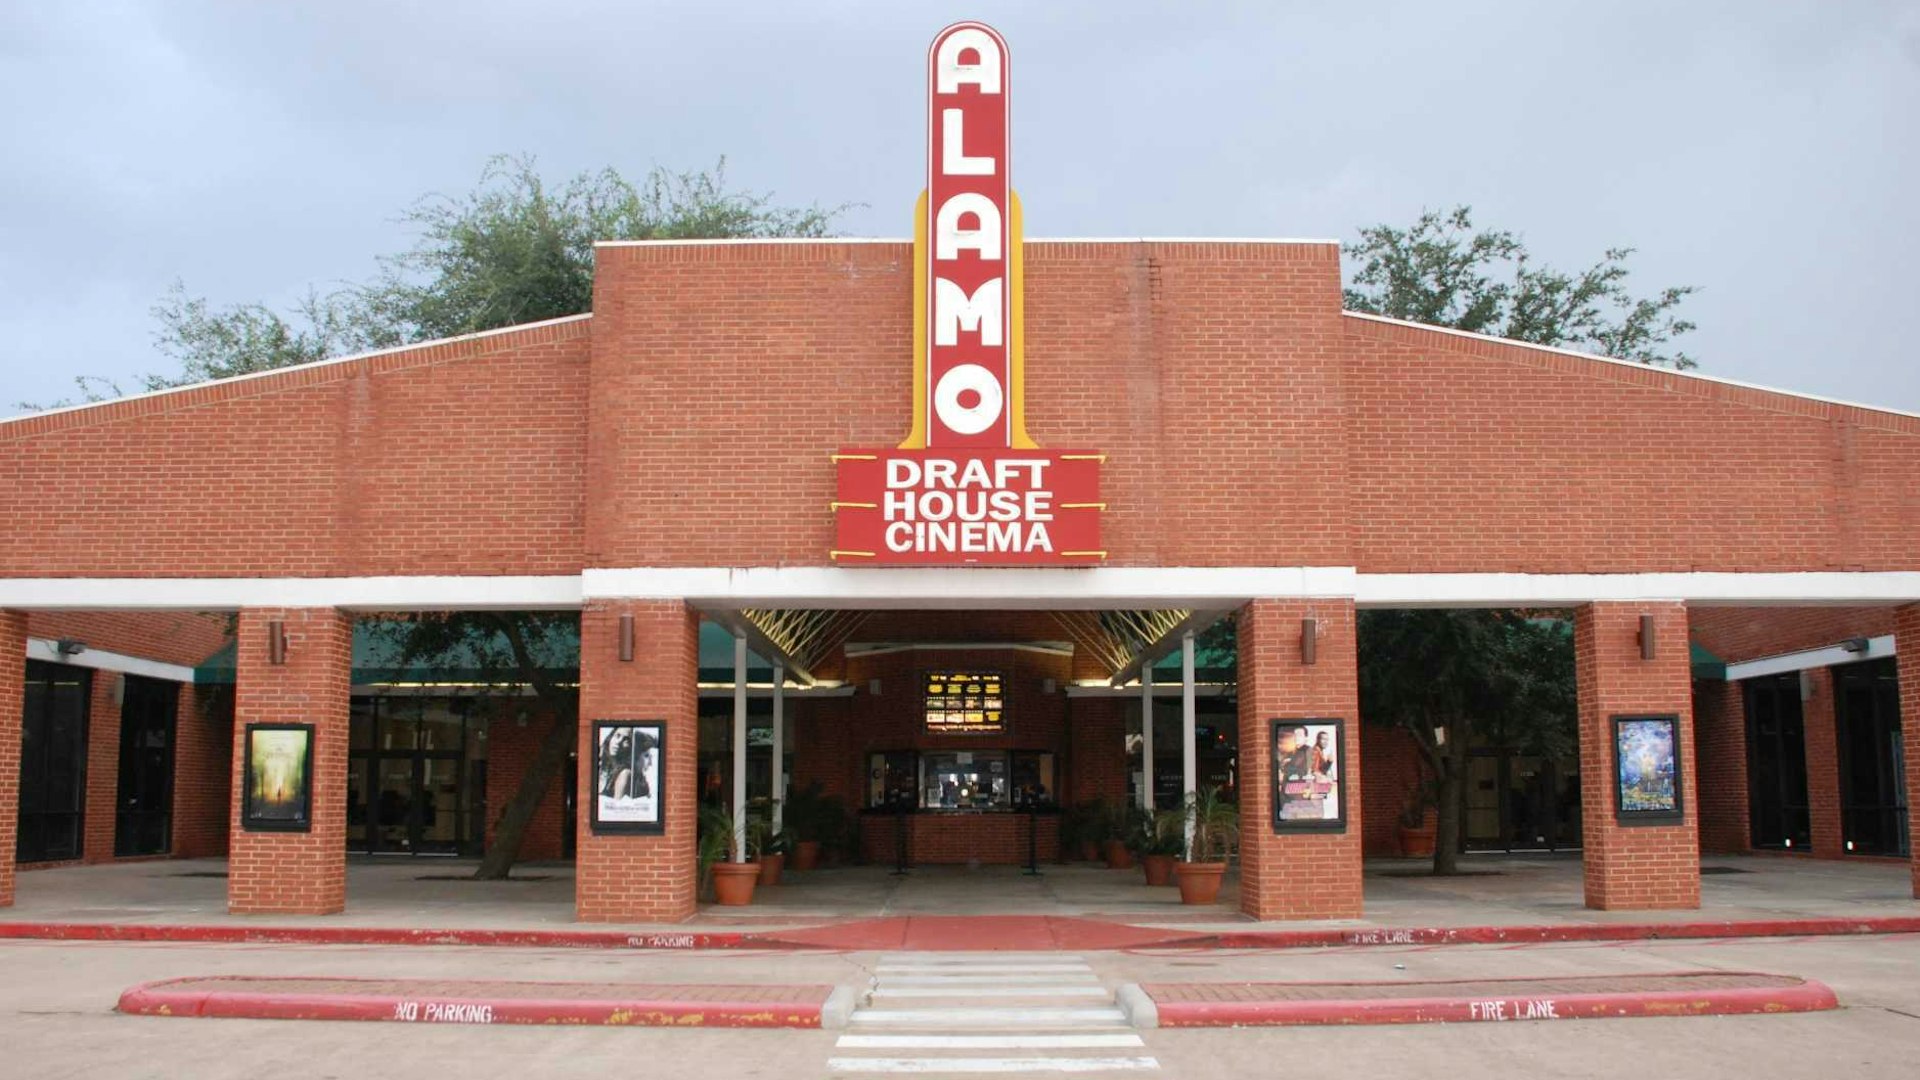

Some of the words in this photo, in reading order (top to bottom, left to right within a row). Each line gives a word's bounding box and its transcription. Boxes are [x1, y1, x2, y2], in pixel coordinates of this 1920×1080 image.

[934, 29, 1003, 435] ALAMO
[886, 458, 1051, 489] DRAFT
[883, 490, 1054, 522] HOUSE
[885, 521, 1054, 552] CINEMA
[1384, 929, 1415, 944] LANE
[394, 1001, 418, 1021] NO
[423, 1003, 493, 1023] PARKING
[1470, 1001, 1507, 1021] FIRE
[1514, 1000, 1560, 1020] LANE
